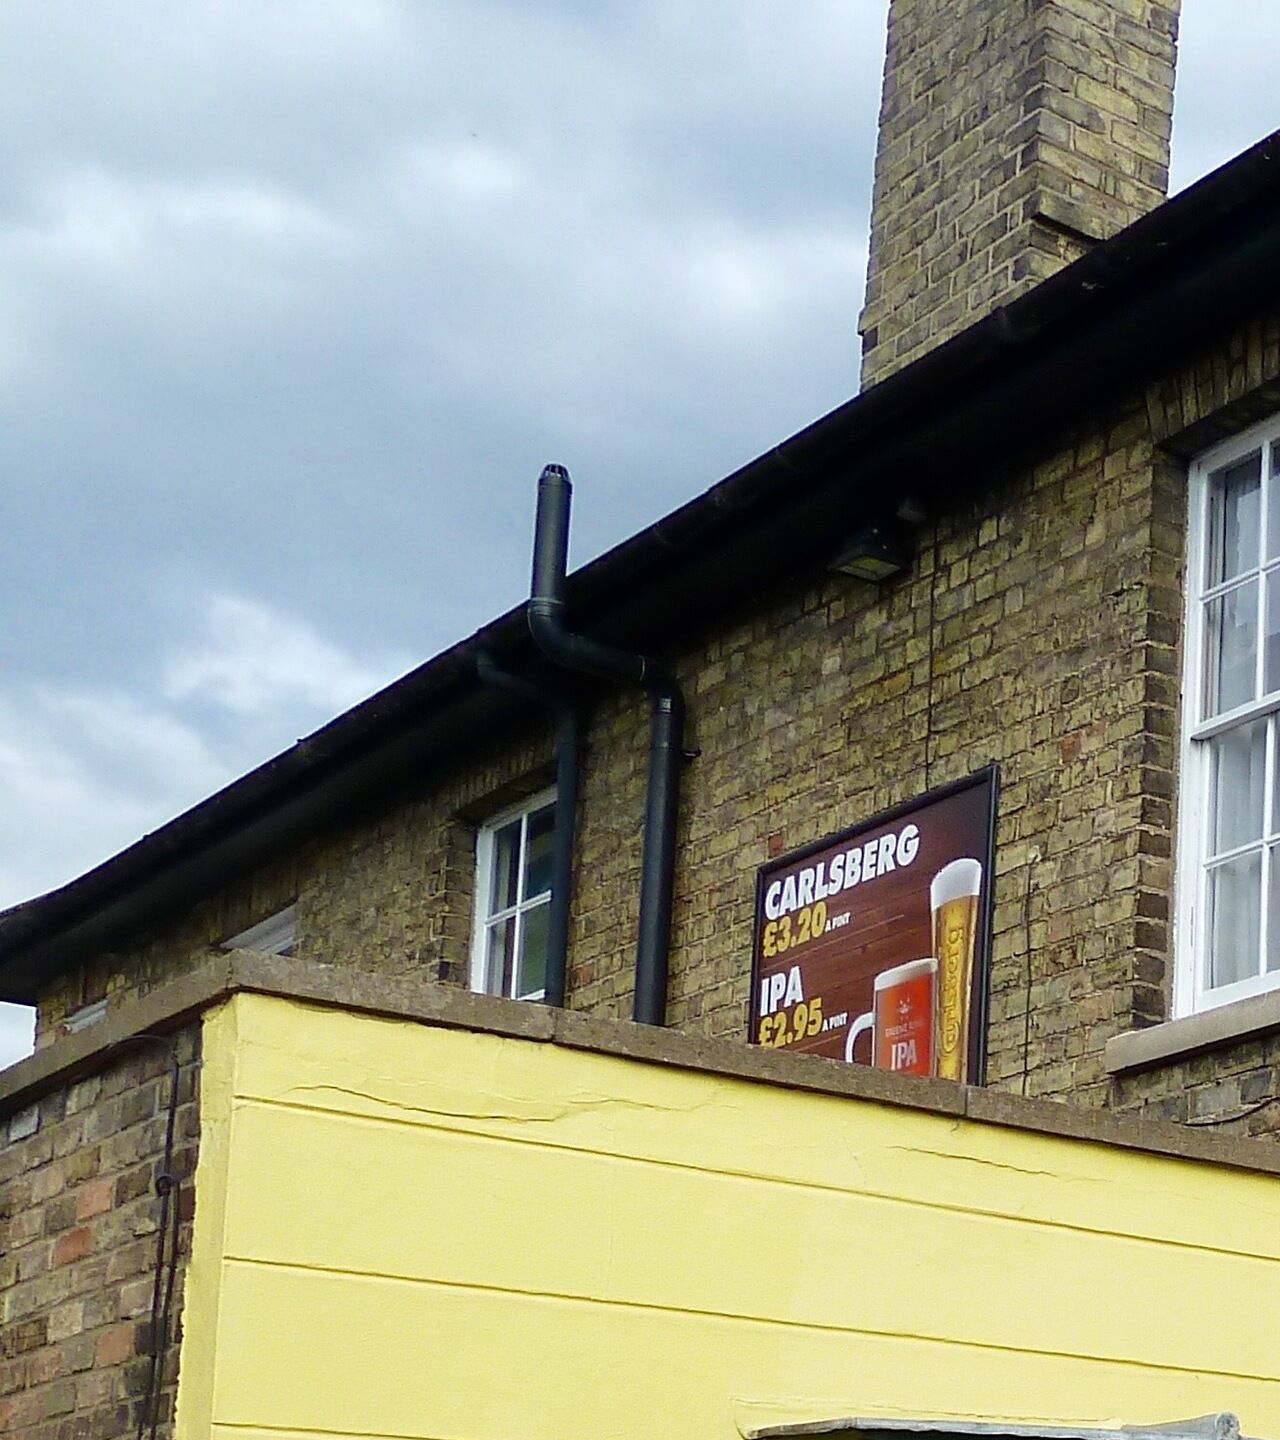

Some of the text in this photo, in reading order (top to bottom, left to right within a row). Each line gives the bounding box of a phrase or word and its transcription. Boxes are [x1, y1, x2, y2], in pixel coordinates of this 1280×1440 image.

[765, 824, 920, 920] CARLSBERG
[763, 901, 850, 957] £3.20 A PINT
[760, 966, 803, 1017] IPA
[759, 997, 848, 1049] £2.95 A PINT
[891, 1039, 917, 1070] IPA
